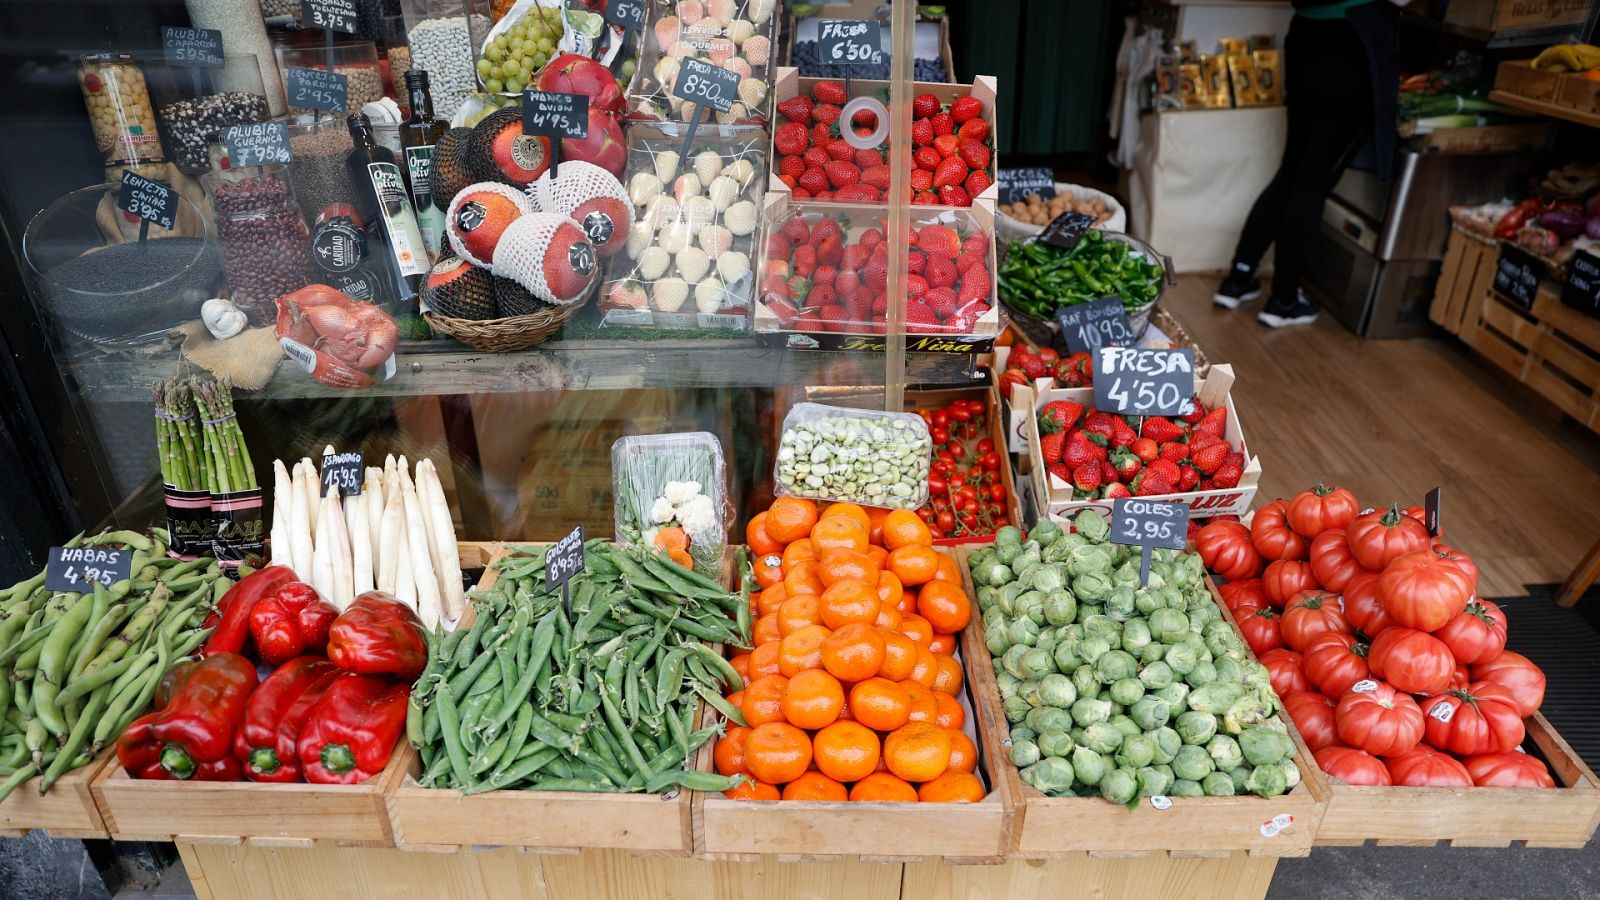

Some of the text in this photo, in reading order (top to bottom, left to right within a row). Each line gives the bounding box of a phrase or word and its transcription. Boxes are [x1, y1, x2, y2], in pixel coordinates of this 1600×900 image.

[314, 11, 344, 28] 3,75
[681, 41, 729, 51] GOURMET
[832, 40, 872, 60] 6'50
[296, 87, 332, 103] 2'95
[683, 75, 721, 100] 8'50
[533, 112, 570, 128] 4'95
[234, 134, 283, 147] GUERNICA
[236, 144, 275, 167] 7'95
[123, 173, 169, 198] LENTEJA
[128, 199, 161, 219] 3'95
[131, 190, 166, 210] CAVIAR
[332, 236, 344, 267] CARIDAD
[341, 280, 367, 294] ARIDAD
[1060, 311, 1081, 327] RAF
[905, 337, 974, 351] Niña
[1100, 347, 1191, 377] FRESA
[1107, 378, 1180, 411] 4'50
[325, 466, 358, 488] 15'95
[1123, 500, 1174, 517] COLES
[1189, 492, 1244, 511] LUZ
[1122, 517, 1177, 540] 2,95
[60, 548, 120, 564] HABAS
[63, 565, 118, 585] 4'95
